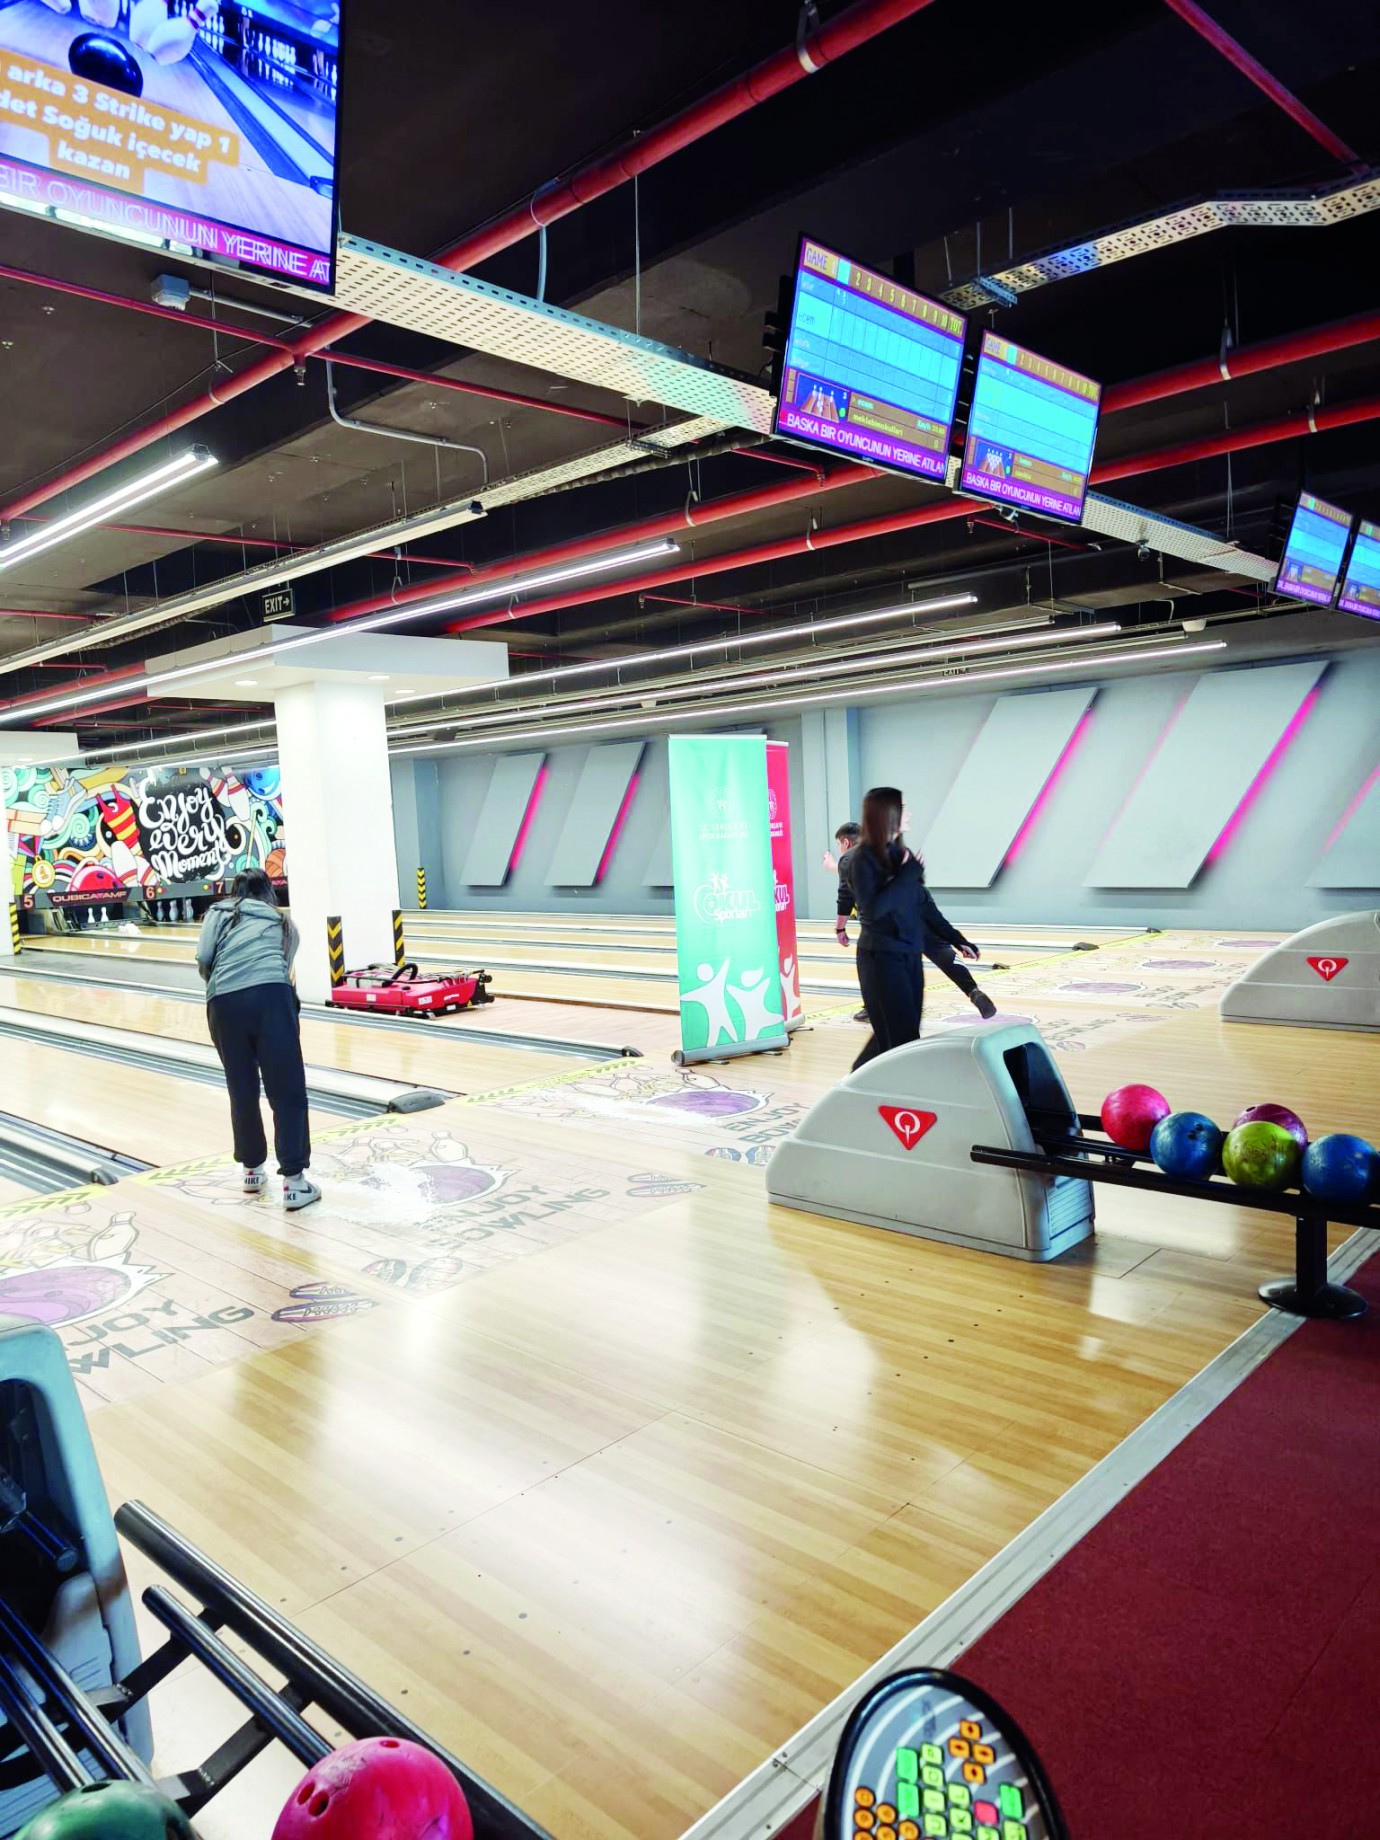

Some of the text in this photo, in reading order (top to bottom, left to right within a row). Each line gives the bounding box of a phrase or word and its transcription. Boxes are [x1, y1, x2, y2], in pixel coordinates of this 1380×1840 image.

[7, 64, 230, 154] arka 3 Strike yap 1
[42, 105, 123, 147] Soğuk
[128, 132, 201, 172] içecek
[57, 140, 130, 180] kazan
[46, 180, 218, 249] OYUNCUNUN
[221, 230, 308, 276] YERINE
[806, 247, 828, 270] GAME
[787, 413, 819, 435] BASKA
[820, 425, 836, 441] BIR
[837, 428, 892, 458] OYUNCUNUN
[893, 445, 921, 467] YERINE
[967, 472, 989, 490] BASKA
[990, 481, 1001, 493] BIR
[1002, 484, 1041, 504] OYUNCUNUN
[1042, 495, 1063, 511] YERINE
[265, 596, 283, 614] EXIT
[139, 776, 212, 834] Enjoy
[149, 814, 227, 855] every
[24, 894, 34, 908] 5
[146, 886, 155, 898] 6
[216, 882, 223, 893] 7
[67, 1299, 179, 1346] JOY
[68, 1306, 255, 1374] WLING
